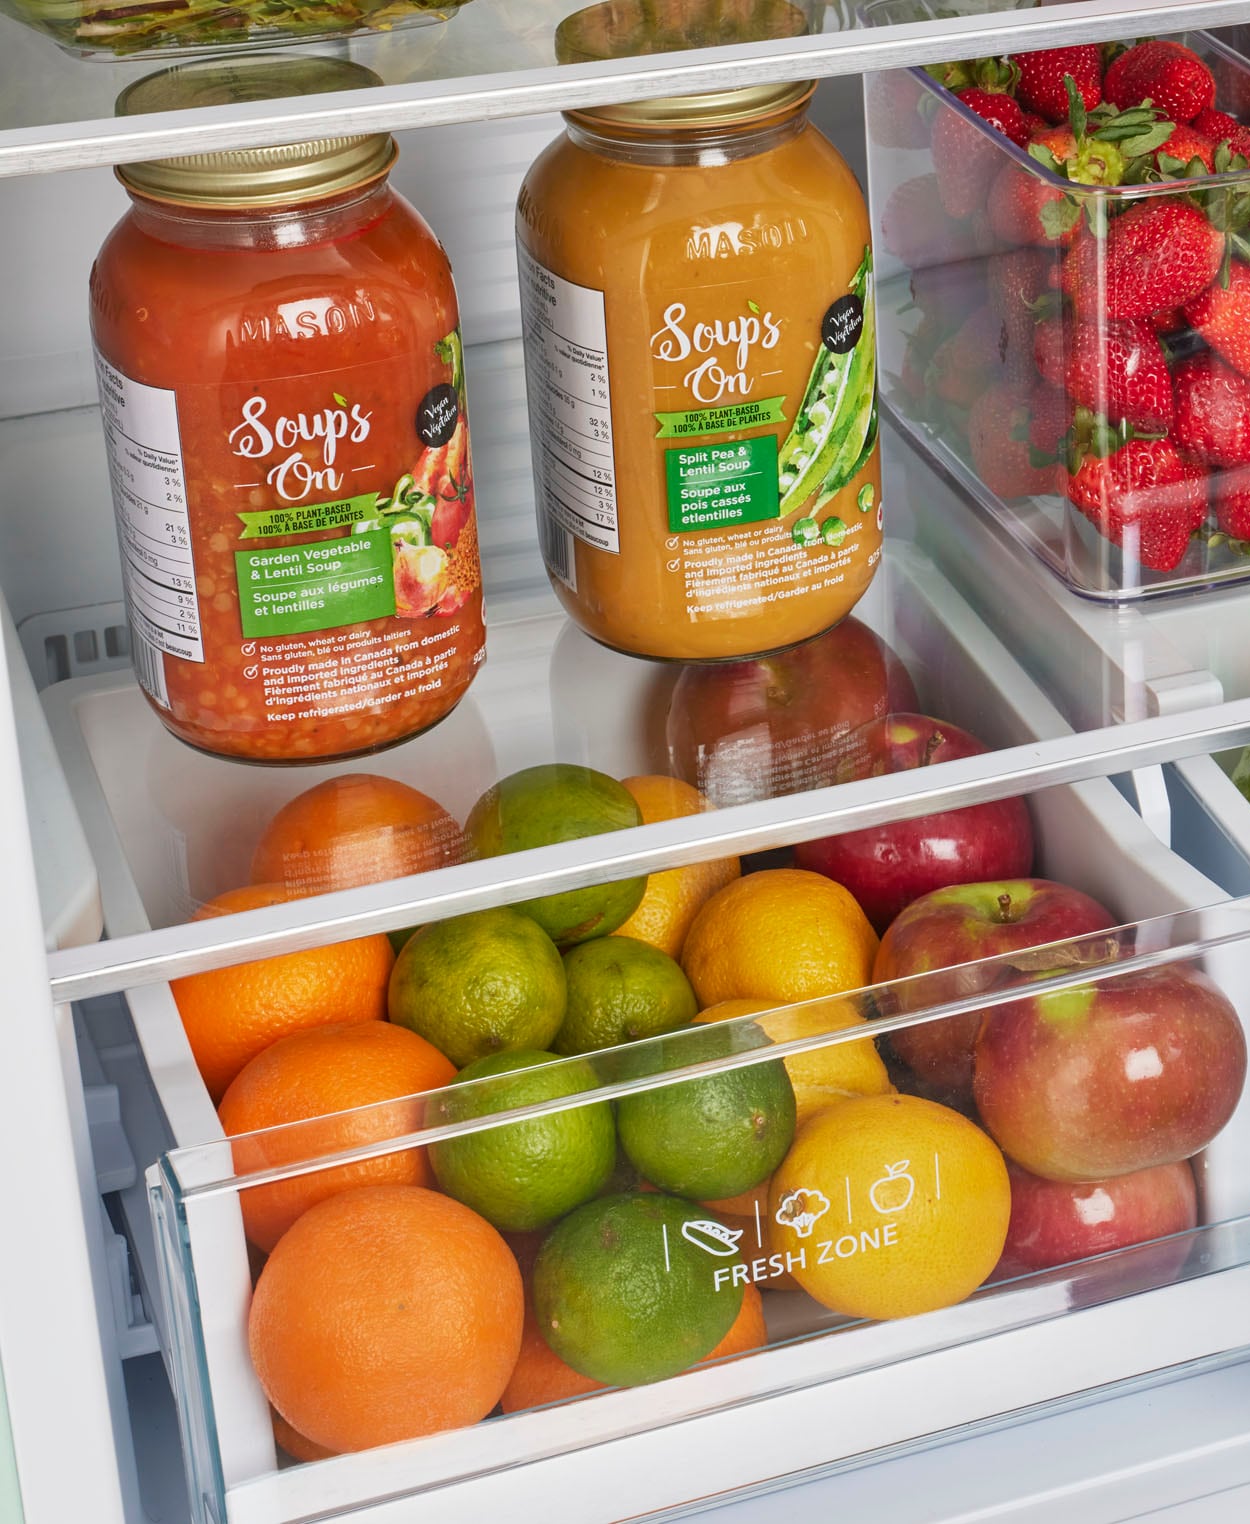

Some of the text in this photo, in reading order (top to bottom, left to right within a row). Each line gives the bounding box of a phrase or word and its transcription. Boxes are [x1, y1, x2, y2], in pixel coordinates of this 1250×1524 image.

[687, 219, 807, 260] MASON
[240, 295, 376, 342] MASON
[829, 307, 854, 327] Vegan
[573, 349, 585, 358] Daily
[590, 373, 606, 384] 2 %
[683, 356, 754, 403] On
[598, 390, 607, 400] %
[424, 397, 449, 418] Vegan
[685, 404, 760, 423] 100% PLANT-BASED
[589, 417, 609, 429] 32 %
[673, 411, 771, 433] 100% À BASE DE PLANTES
[594, 429, 610, 440] 3 %
[143, 451, 158, 462] Daily
[678, 446, 747, 465] Split Pea &
[266, 452, 345, 501] On
[593, 469, 612, 481] 12 %
[679, 460, 751, 477] Lentil Soup
[164, 476, 181, 487] 3 %
[680, 482, 747, 499] Soupe aux
[166, 492, 183, 504] 2 %
[594, 486, 613, 498] 12 %
[598, 500, 614, 511] 3 %
[681, 493, 751, 513] pois cassés
[258, 510, 364, 534] 100% À BASE DE PLANTES
[269, 503, 352, 524] 100% PLANT-BASED
[596, 513, 615, 525] 17 %
[681, 508, 743, 524] etlentilles
[165, 523, 187, 535] 21 %
[697, 536, 725, 547] gluten,
[727, 531, 752, 541] wheat
[763, 525, 784, 535] dairy
[171, 535, 188, 546] 3 %
[684, 557, 723, 569] Proudly
[726, 553, 753, 563] made
[756, 550, 766, 558] in
[767, 543, 803, 557] Canada
[804, 536, 825, 548] from
[827, 522, 863, 541] domestic
[704, 543, 733, 554] gluten,
[761, 532, 792, 544] produits
[249, 540, 372, 567] Garden Vegetable
[250, 560, 342, 580] & Lentil Soup
[684, 551, 808, 579] and imported ingredients
[685, 543, 860, 588] Fièrement fabriqué au Canada à partir
[171, 577, 193, 589] 13 %
[685, 557, 852, 598] d'ingrédients nationaux et importés
[253, 574, 384, 603] Soupe aux légumes
[686, 604, 713, 614] Keep
[811, 582, 822, 591] au
[823, 573, 845, 587] froid
[177, 595, 194, 606] 9 %
[254, 599, 325, 616] et lentilles
[180, 609, 196, 620] 2 %
[177, 623, 198, 634] 11 %
[259, 645, 274, 653] No
[275, 642, 306, 653] gluten,
[308, 636, 335, 647] wheat
[348, 630, 371, 640] dairy
[260, 629, 412, 662] Sans gluten, blé ou produits laitiers
[262, 624, 461, 676] Proudly made in Canada from domestic
[263, 656, 399, 686] and imported ingredients
[264, 647, 457, 696] Fièrement fabriqué au Canada à partir
[265, 661, 449, 706] d'ingrédients nationaux et importés
[267, 679, 442, 721] Keep refrigerated/Garder au froid
[713, 1223, 899, 1292] FRESH ZONE
